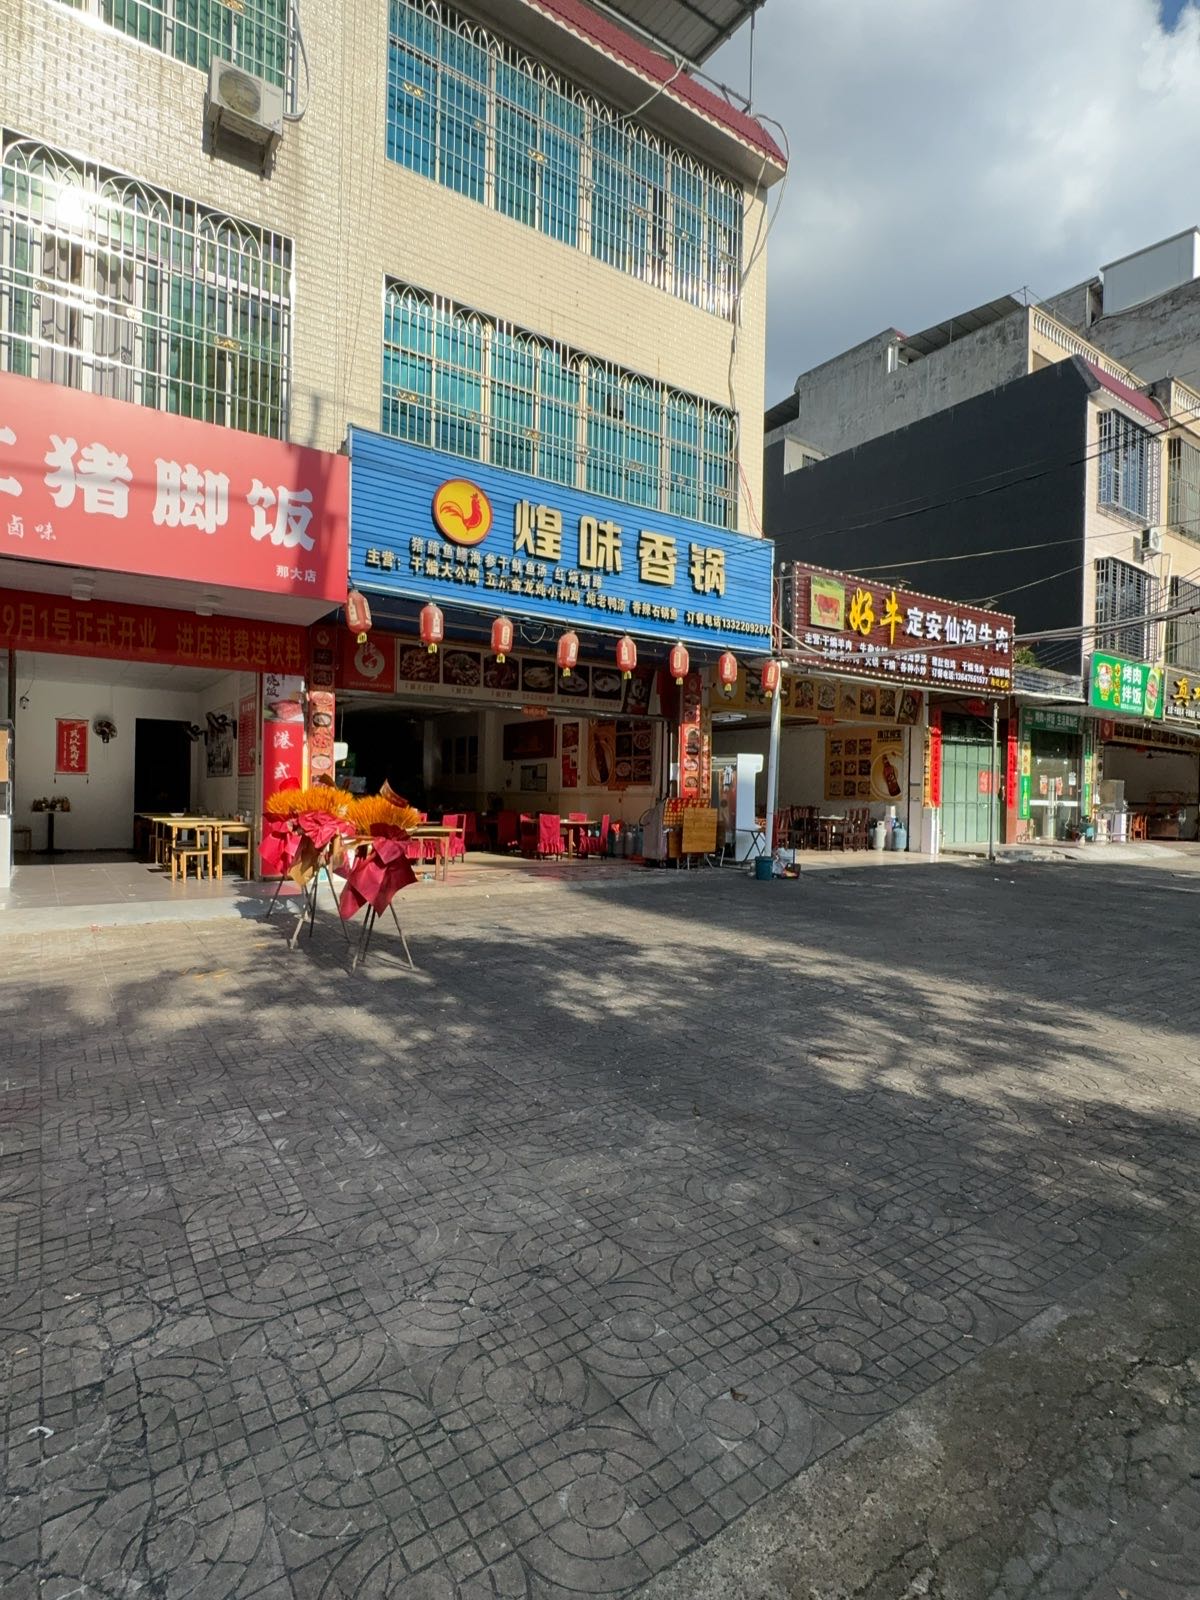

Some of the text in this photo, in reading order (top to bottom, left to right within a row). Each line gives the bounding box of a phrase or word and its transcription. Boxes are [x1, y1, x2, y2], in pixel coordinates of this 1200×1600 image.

[7, 513, 57, 541] 卤味
[514, 499, 726, 596] 煌味香锅
[275, 564, 317, 583] 那大店
[2, 603, 302, 668] 9月1号正式开业 进店消费送饮料
[906, 606, 1009, 653] 定安仙沟牛肉
